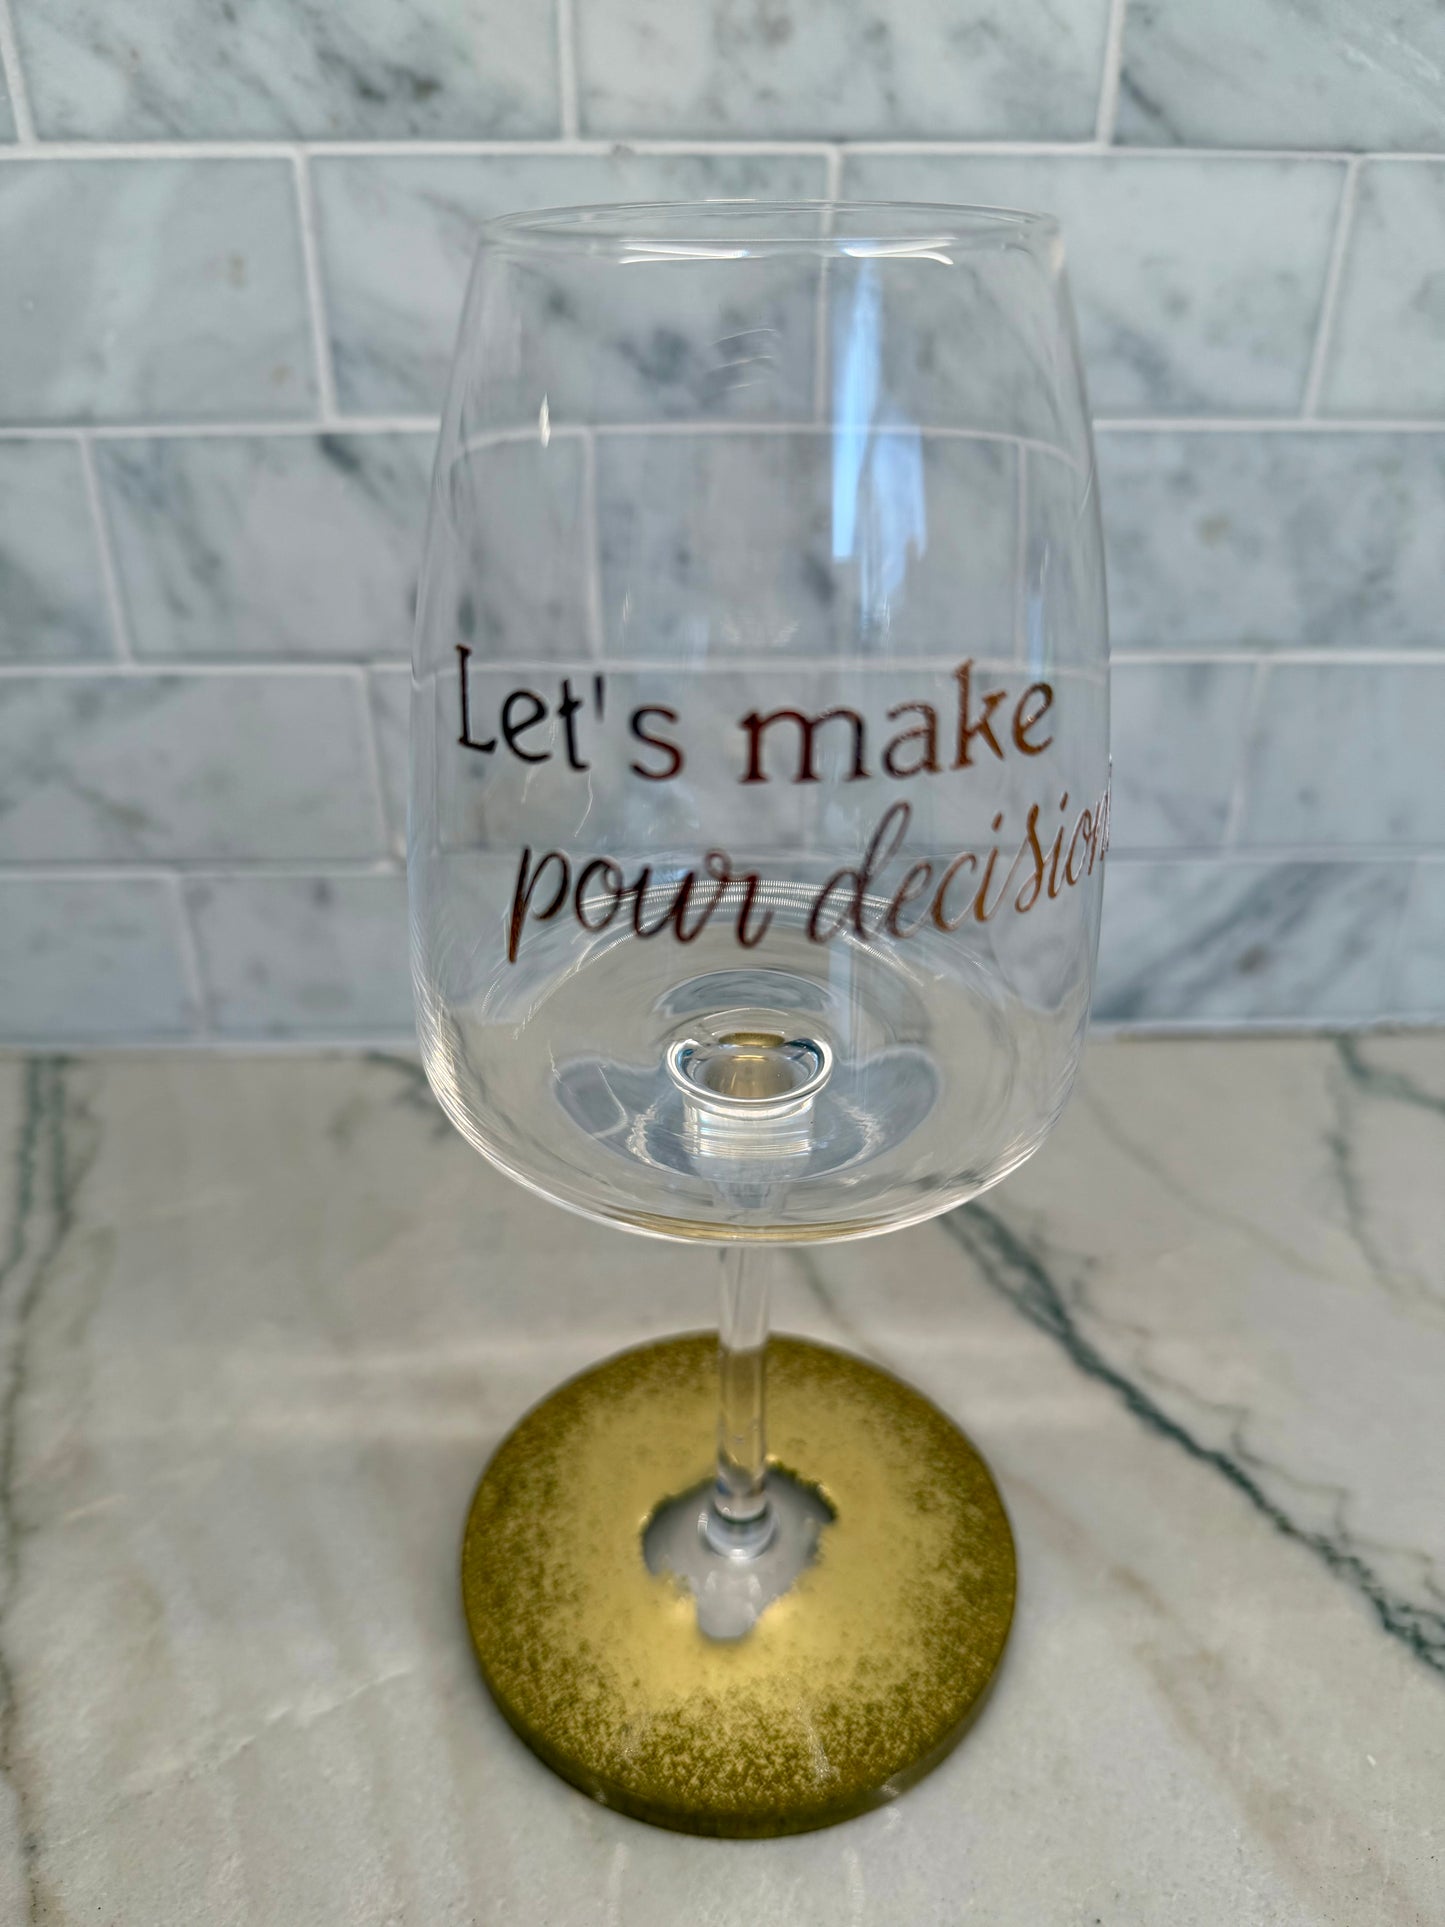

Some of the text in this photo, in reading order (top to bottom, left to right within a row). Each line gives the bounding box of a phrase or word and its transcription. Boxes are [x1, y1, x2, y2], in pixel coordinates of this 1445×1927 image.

[455, 644, 1054, 784] Let's make
[507, 772, 1111, 964] pour decision
